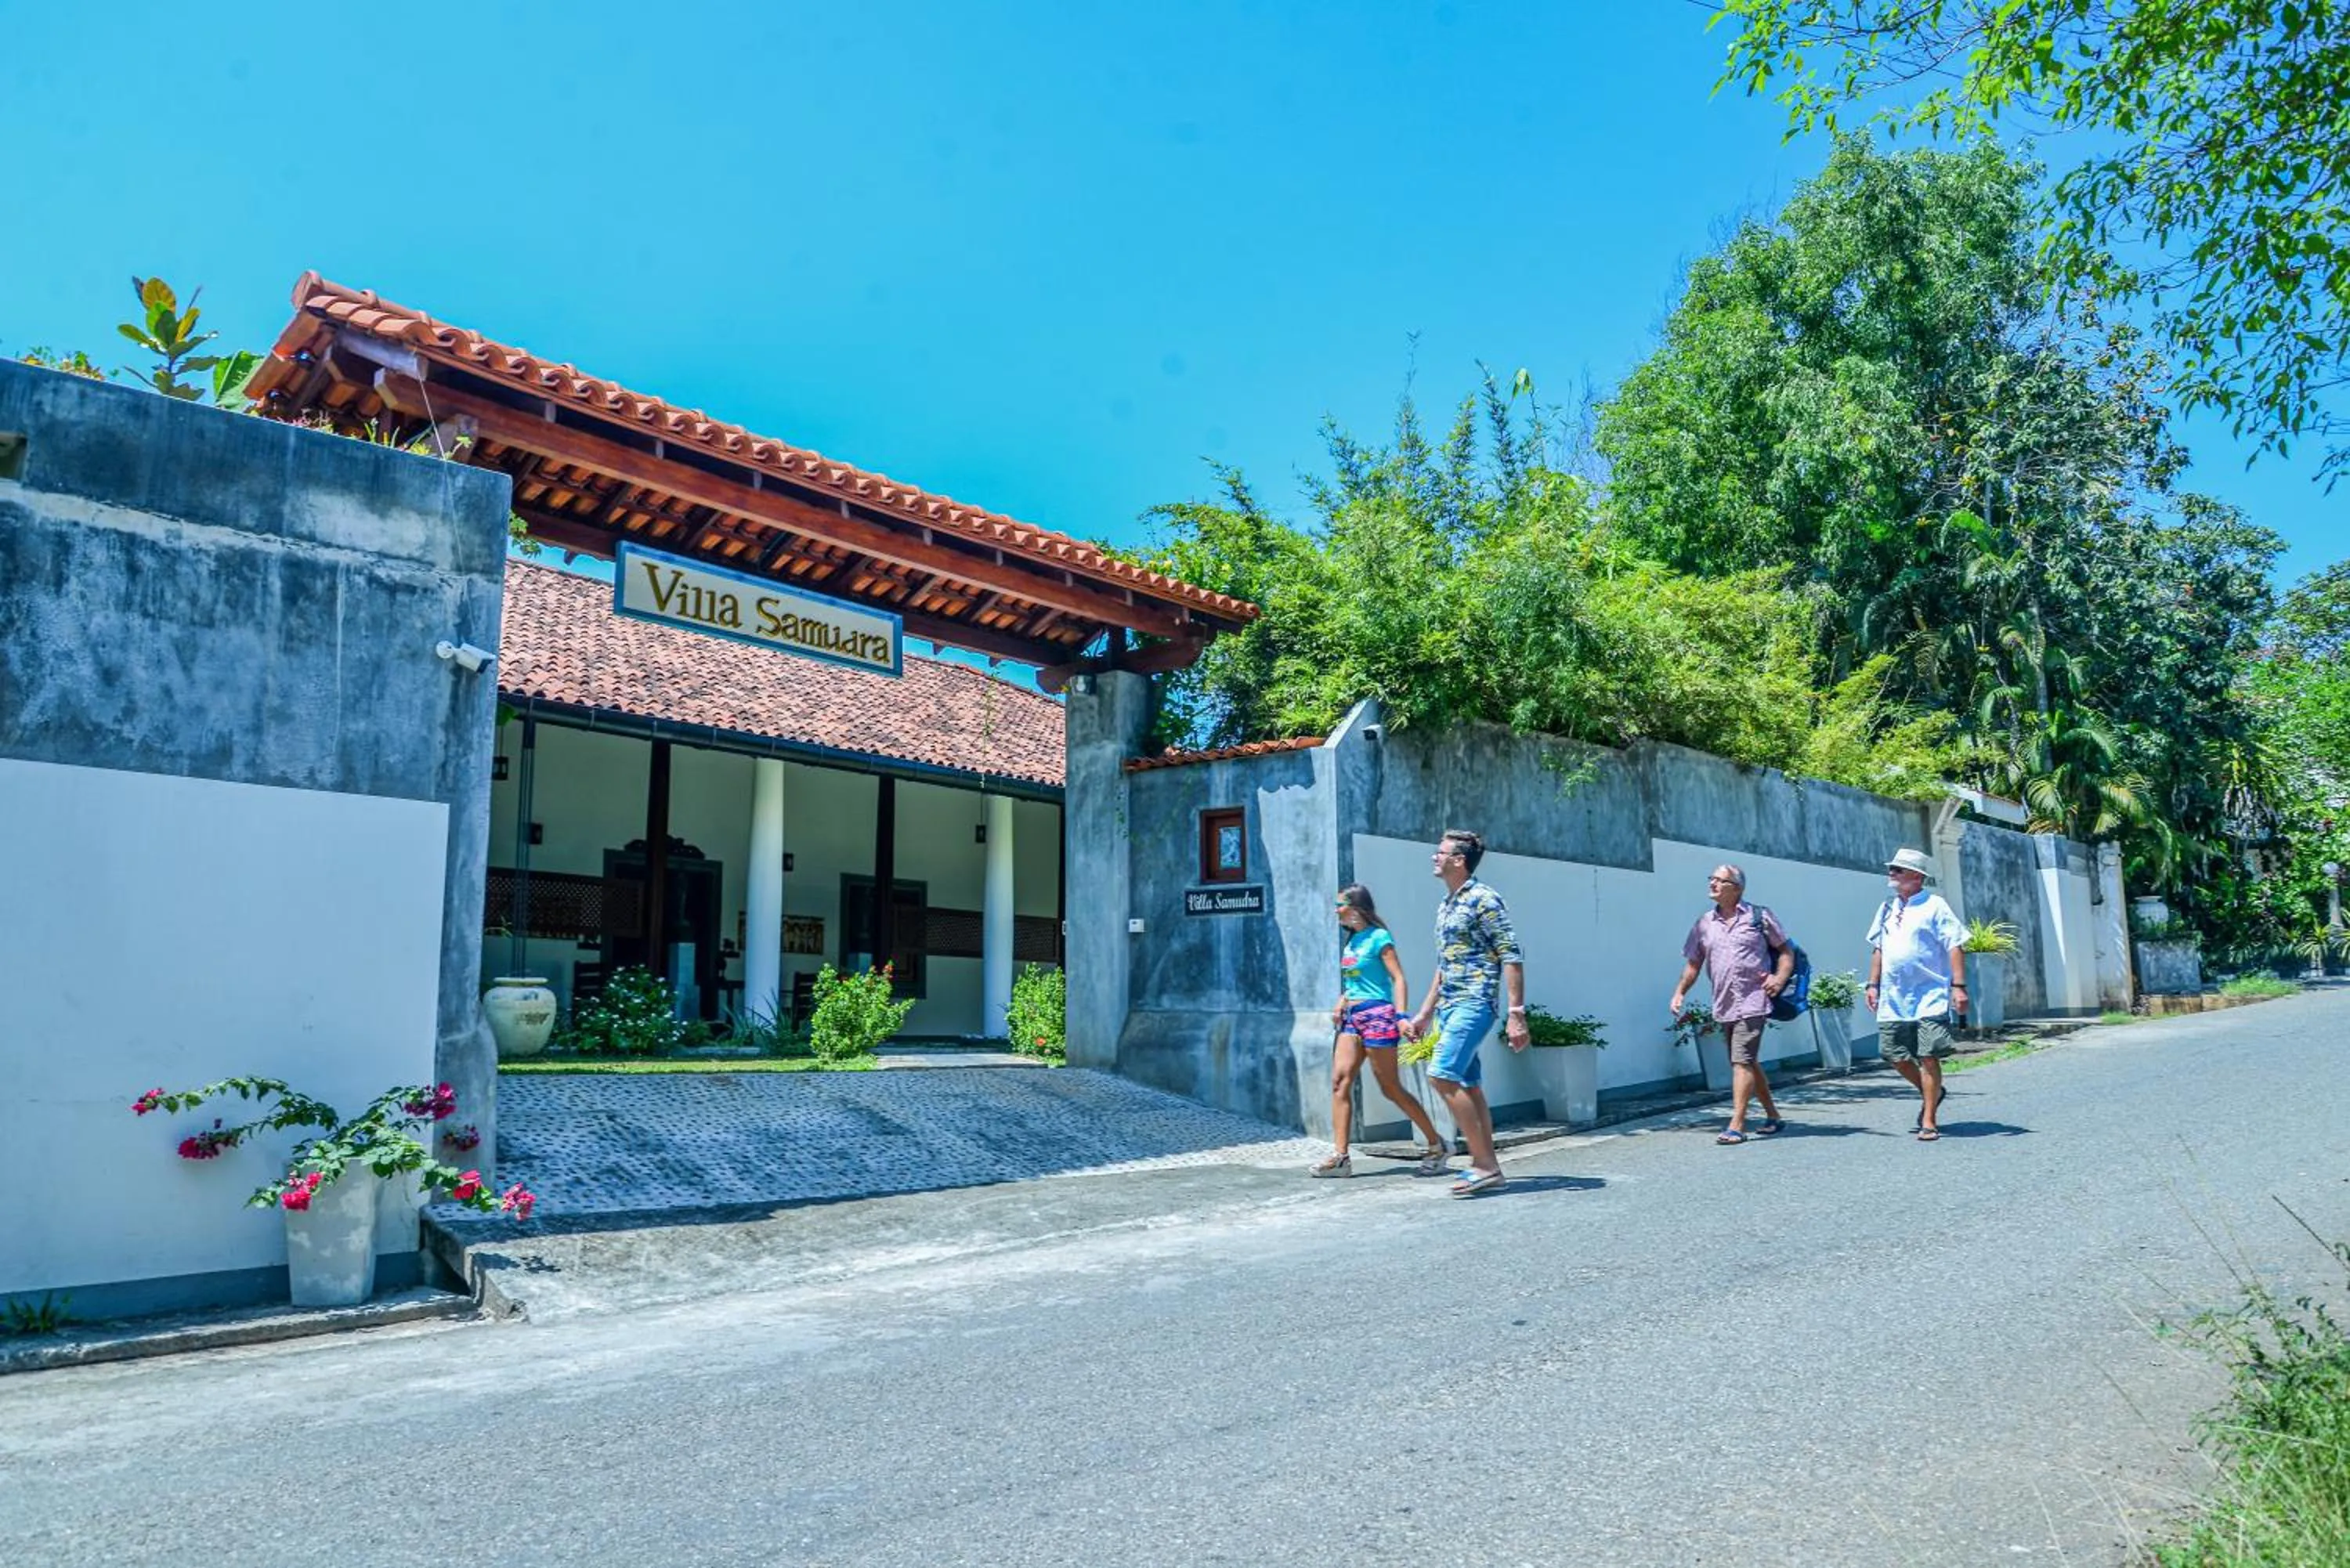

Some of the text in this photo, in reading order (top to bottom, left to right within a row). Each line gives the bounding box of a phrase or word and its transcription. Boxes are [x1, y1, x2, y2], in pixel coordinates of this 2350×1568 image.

[642, 562, 743, 628] Villa
[1188, 891, 1260, 910] Villa Samudra
